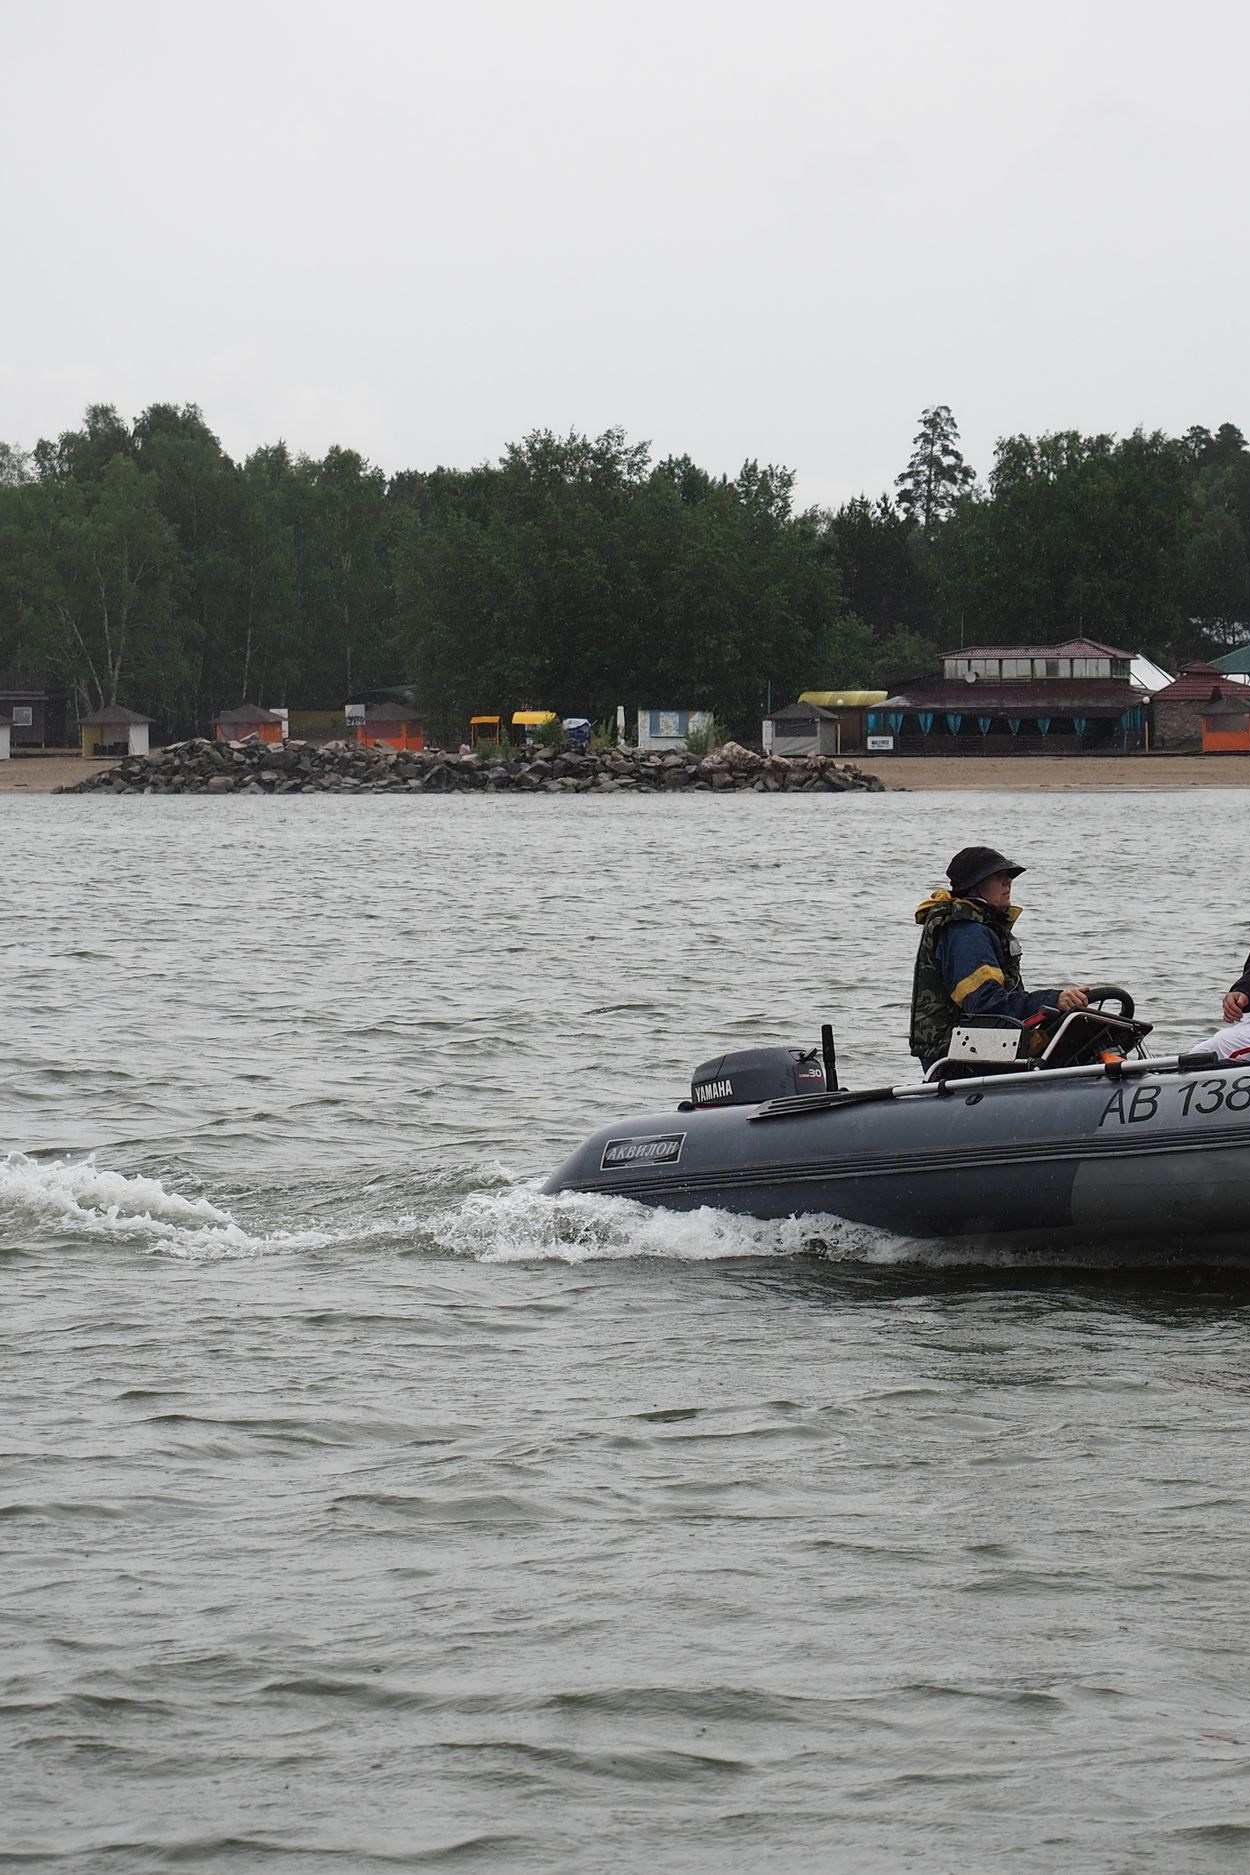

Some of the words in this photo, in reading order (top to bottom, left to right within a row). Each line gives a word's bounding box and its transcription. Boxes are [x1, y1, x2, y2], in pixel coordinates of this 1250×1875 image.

[808, 1068, 822, 1078] 30
[695, 1079, 733, 1103] YAMAHA
[1098, 1085, 1161, 1127] AB
[606, 1141, 679, 1161] АКВИЛОН
